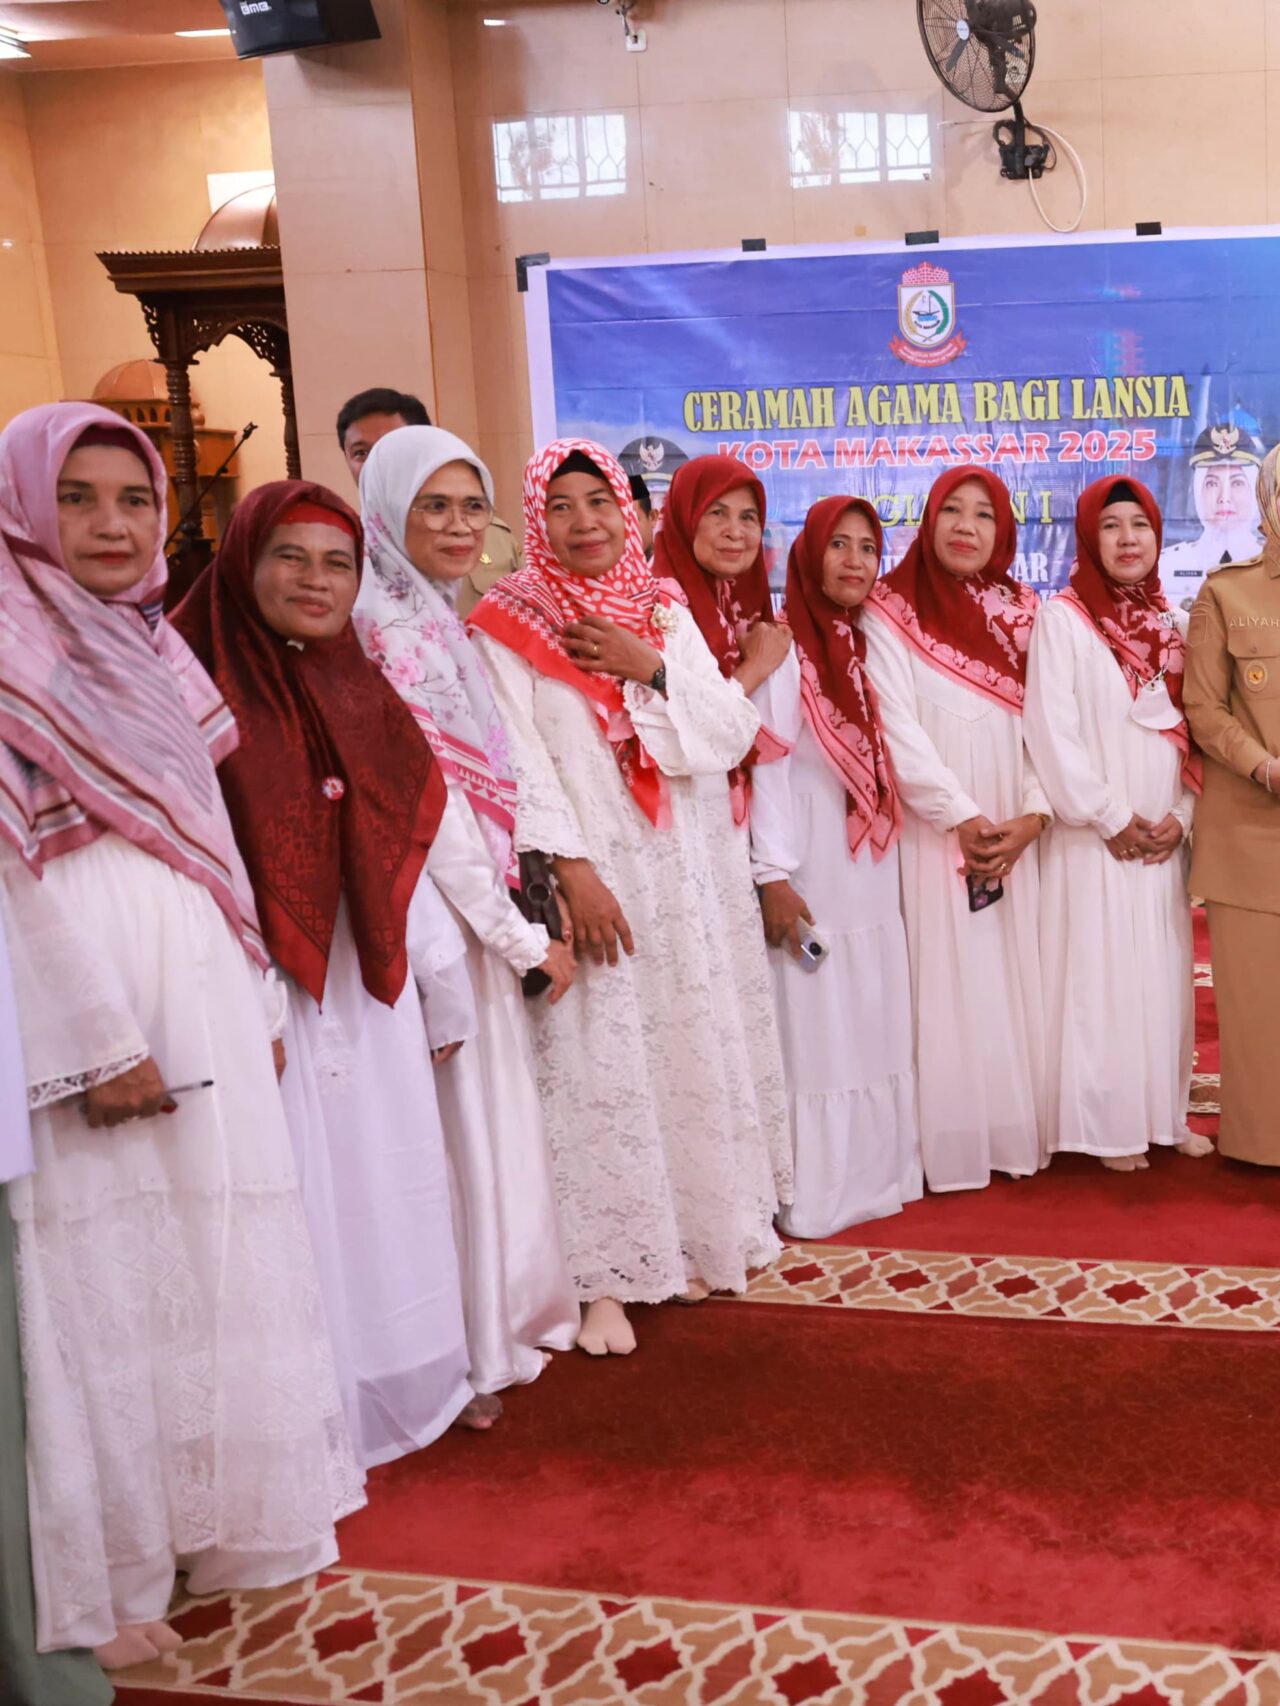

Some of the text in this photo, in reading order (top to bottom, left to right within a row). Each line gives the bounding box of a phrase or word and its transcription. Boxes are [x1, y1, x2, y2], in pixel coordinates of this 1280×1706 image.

[683, 374, 1191, 432] CERAMAH AGAMA BAGI LANSIA
[834, 432, 1050, 468] MAKASSAR
[1058, 429, 1157, 463] 2025
[1229, 615, 1280, 628] ALIYAH
